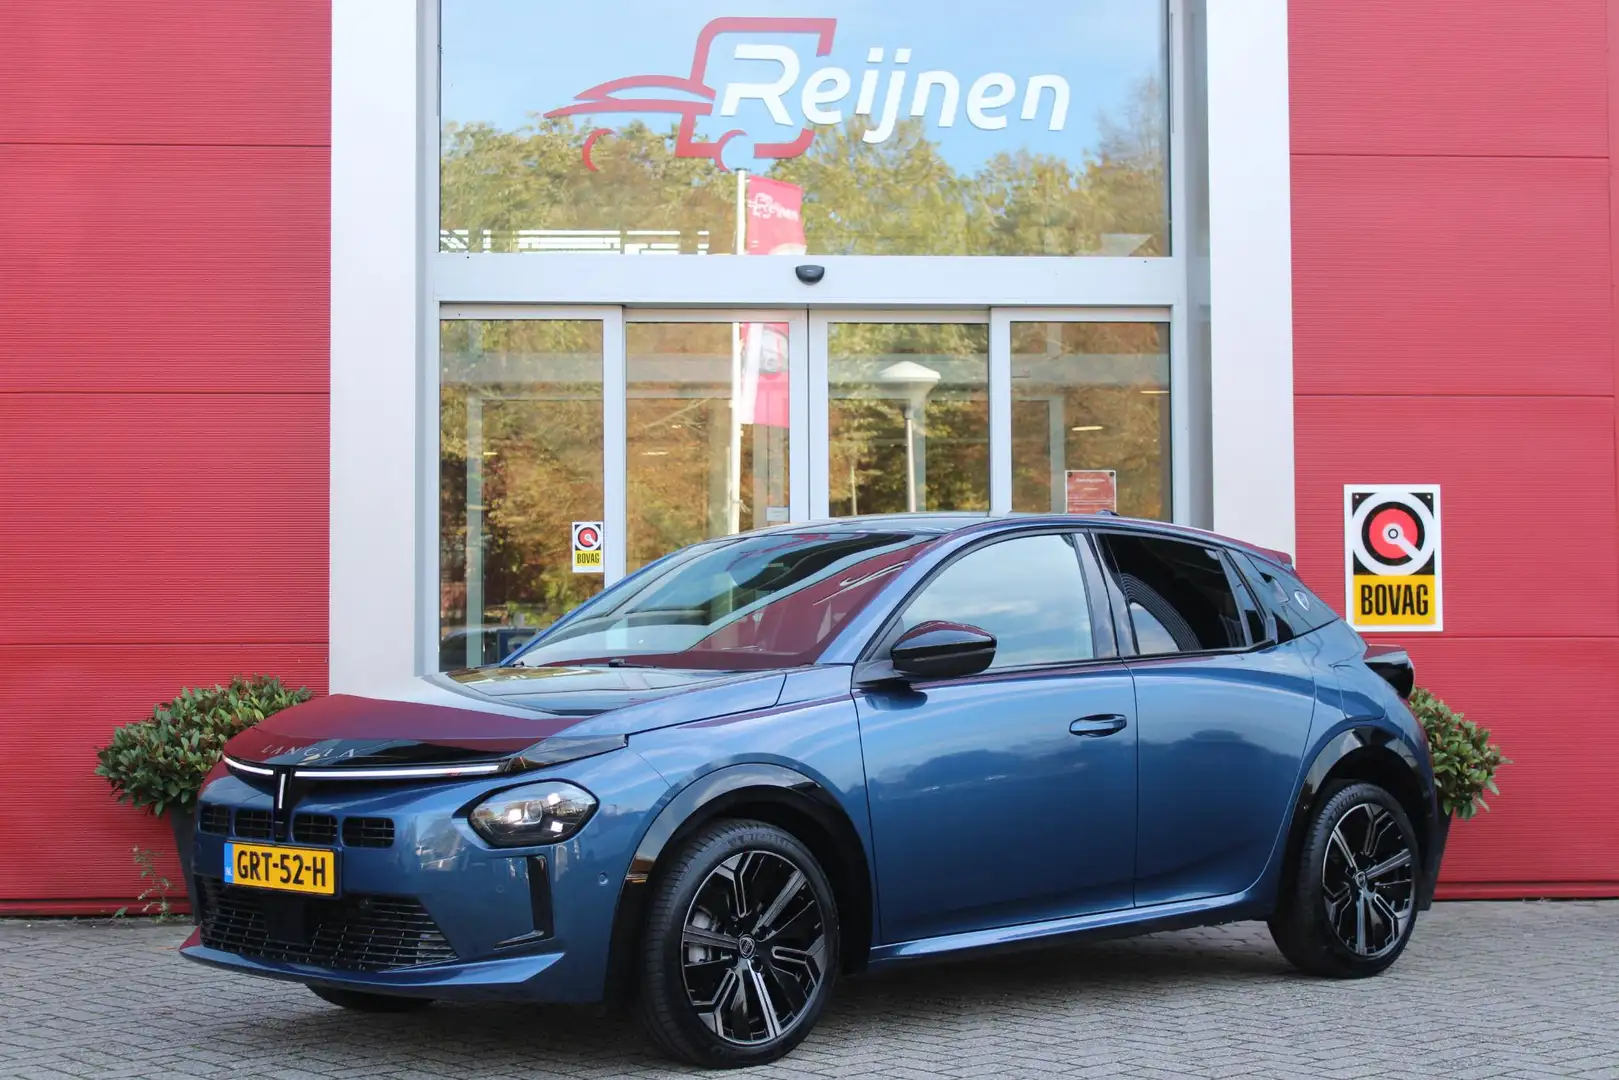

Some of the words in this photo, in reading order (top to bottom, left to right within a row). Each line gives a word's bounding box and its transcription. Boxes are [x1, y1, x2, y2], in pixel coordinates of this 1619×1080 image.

[719, 44, 1071, 144] Reijnen
[577, 553, 600, 564] BOVAG
[1360, 584, 1429, 616] BOVAG
[261, 744, 355, 758] LANCIA
[237, 850, 326, 887] GRT-52-H
